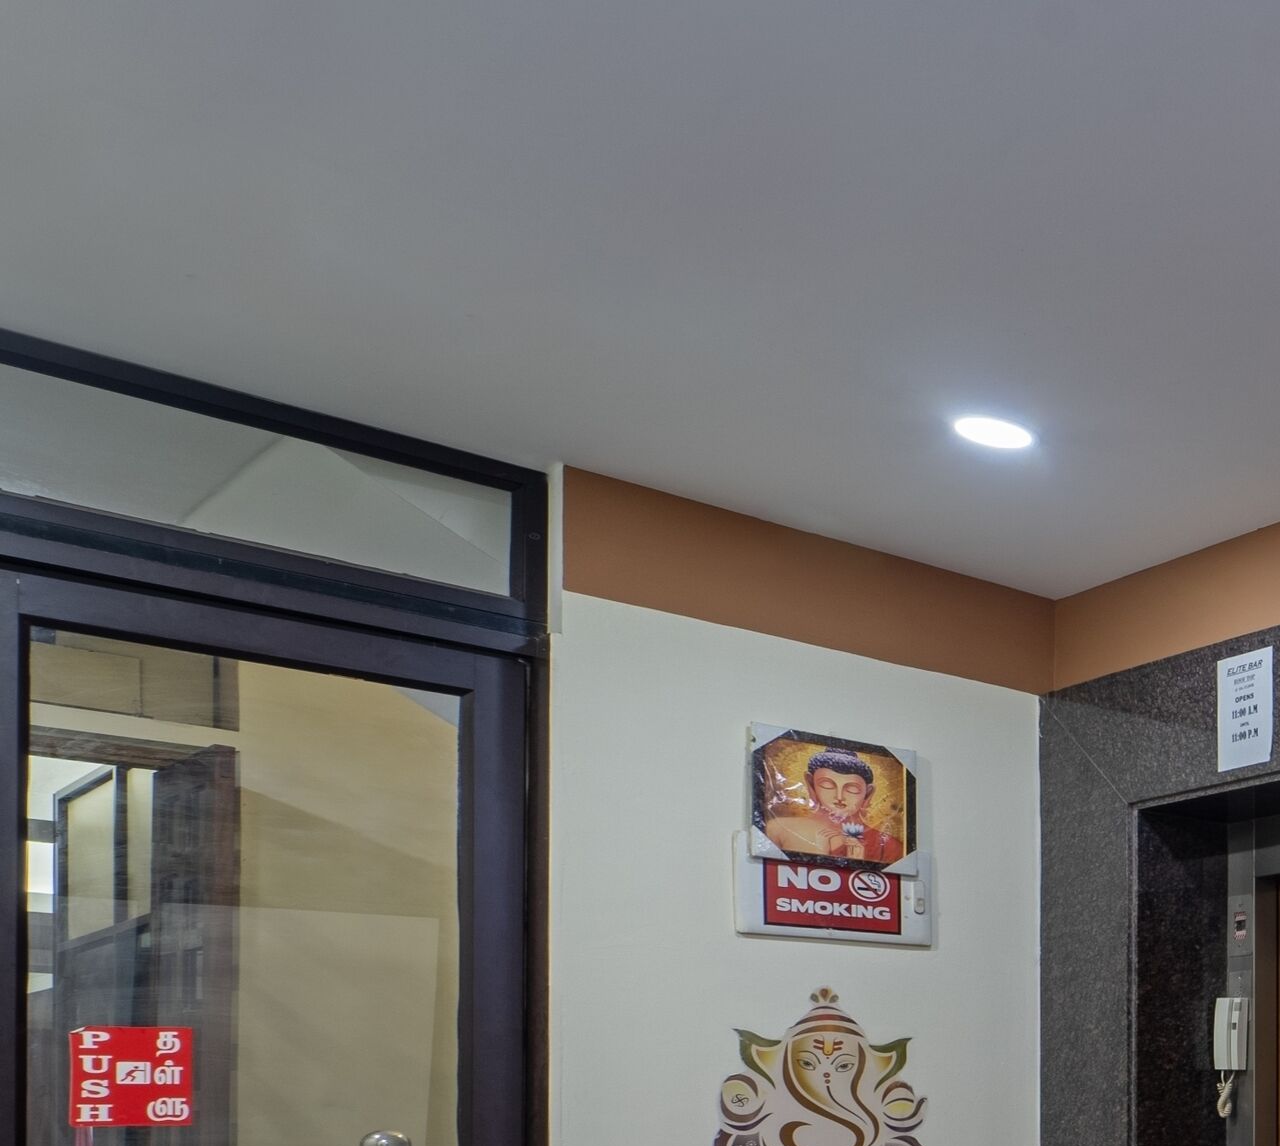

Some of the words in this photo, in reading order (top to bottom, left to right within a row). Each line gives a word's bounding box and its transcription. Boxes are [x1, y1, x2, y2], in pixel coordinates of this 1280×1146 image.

[1227, 663, 1247, 676] ELITE
[1248, 659, 1263, 670] BAR
[1235, 693, 1254, 703] OPENS
[777, 865, 841, 892] NO
[776, 897, 891, 921] SMOKING
[76, 1030, 113, 1122] PUSH
[147, 1031, 190, 1121] தள்ளு
